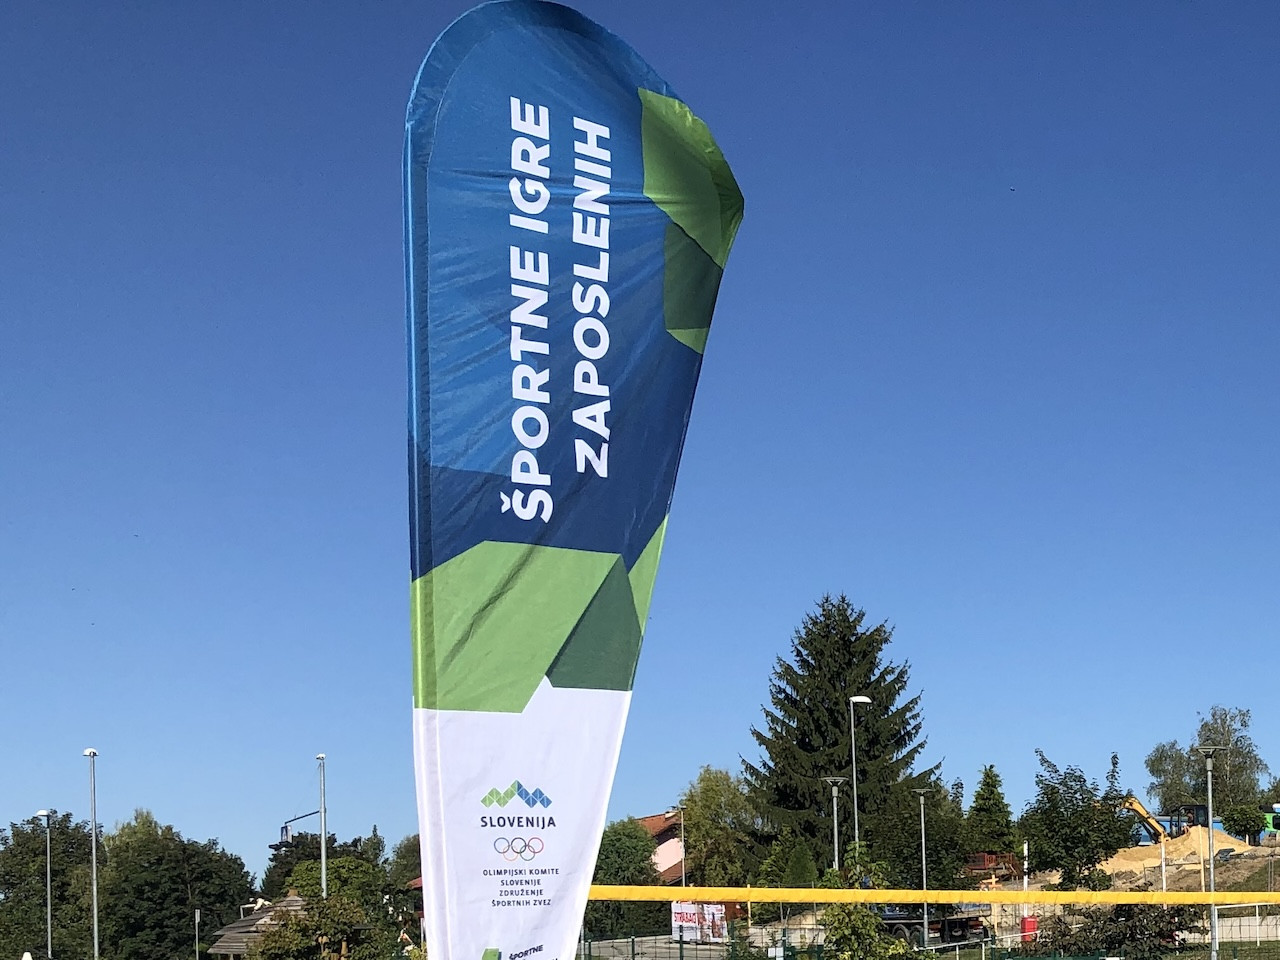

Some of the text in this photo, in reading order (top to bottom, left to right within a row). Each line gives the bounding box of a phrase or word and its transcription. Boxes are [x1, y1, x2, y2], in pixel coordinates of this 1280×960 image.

[572, 116, 611, 479] ZAPOSLENIH
[500, 96, 554, 524] ŠPORTNE IGRE
[480, 816, 557, 830] SLOVENIJA
[482, 868, 560, 877] OLIMPIJSKI KOMITE
[500, 879, 542, 887] SLOVENIJE
[499, 888, 544, 897] ZDRUŽENJE
[491, 898, 552, 907] ŠPORTNIH ZVEZ
